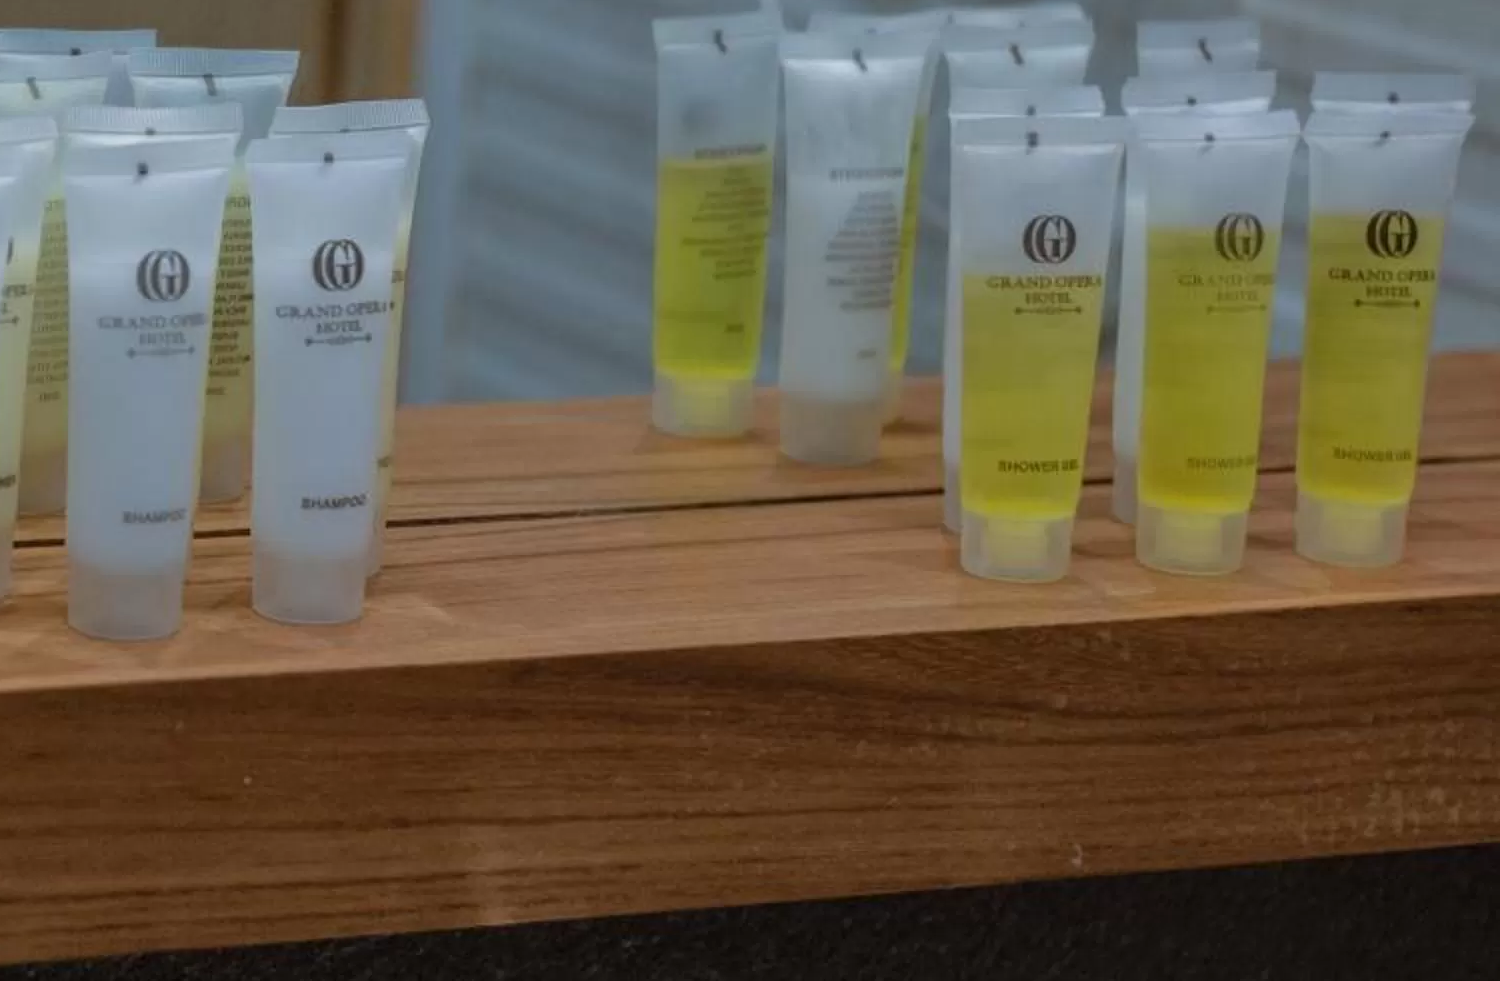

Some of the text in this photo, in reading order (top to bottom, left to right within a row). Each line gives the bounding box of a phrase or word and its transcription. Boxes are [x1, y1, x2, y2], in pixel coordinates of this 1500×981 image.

[984, 275, 1052, 289] GRAND
[1327, 268, 1393, 283] GRAND
[1025, 292, 1072, 305] HOTEL
[1365, 286, 1412, 298] HOTEL
[275, 303, 343, 320] GRAND
[97, 316, 167, 331] GRAND
[315, 318, 364, 335] HOTEL
[139, 330, 187, 345] HOTEL
[998, 459, 1059, 473] SHOWER
[301, 493, 369, 510] SHAMPOO
